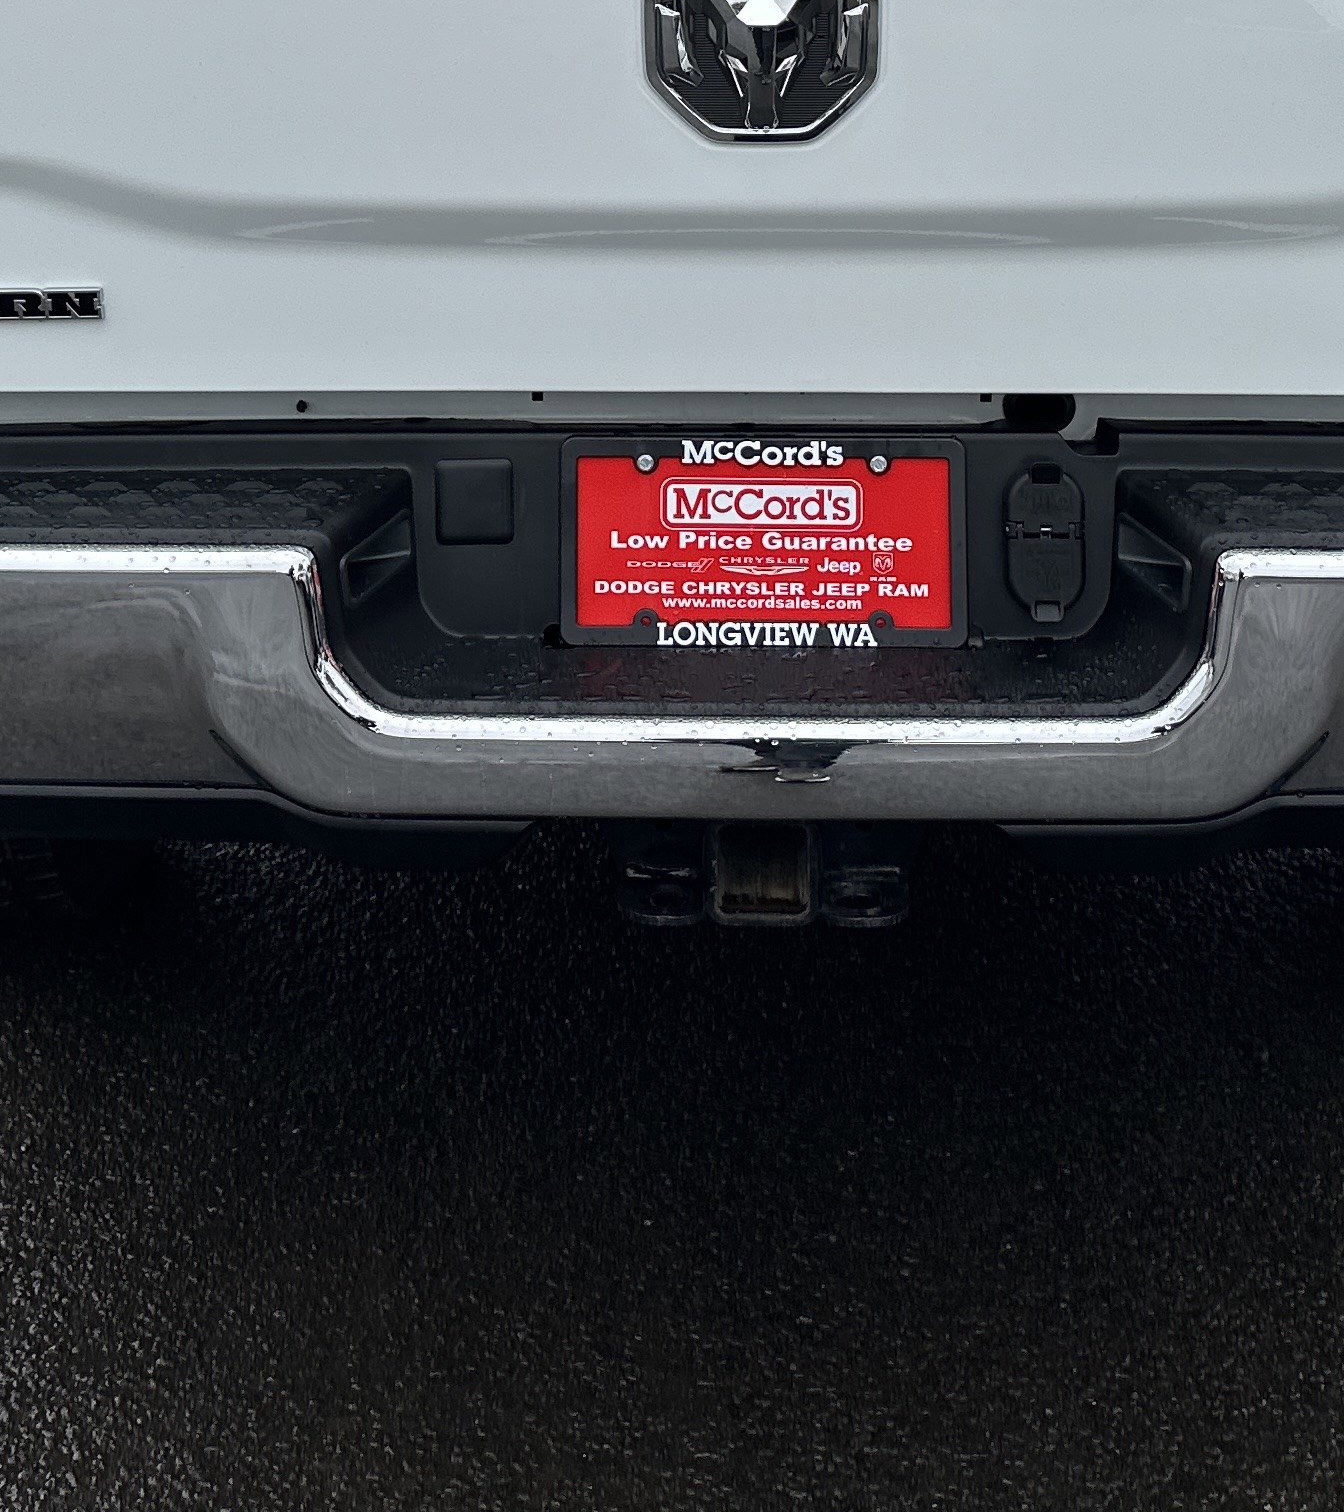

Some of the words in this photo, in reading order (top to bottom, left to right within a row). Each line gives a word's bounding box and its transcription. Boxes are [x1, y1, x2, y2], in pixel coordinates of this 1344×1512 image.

[681, 439, 844, 466] McCord's
[672, 488, 851, 521] McCord's
[610, 531, 670, 549] Low
[678, 531, 753, 550] Price
[761, 531, 913, 552] Guarantee
[626, 560, 702, 568] DODGE
[719, 556, 810, 565] CHRYSLER
[816, 557, 861, 576] Jeep
[594, 580, 674, 595] DODGE
[681, 581, 806, 596] CHRYSLER
[811, 582, 871, 596] JEEP
[877, 583, 929, 598] RAM
[662, 597, 862, 610] www.mccordsales.com
[656, 622, 819, 646] LONGVIEW
[826, 623, 878, 647] WA
